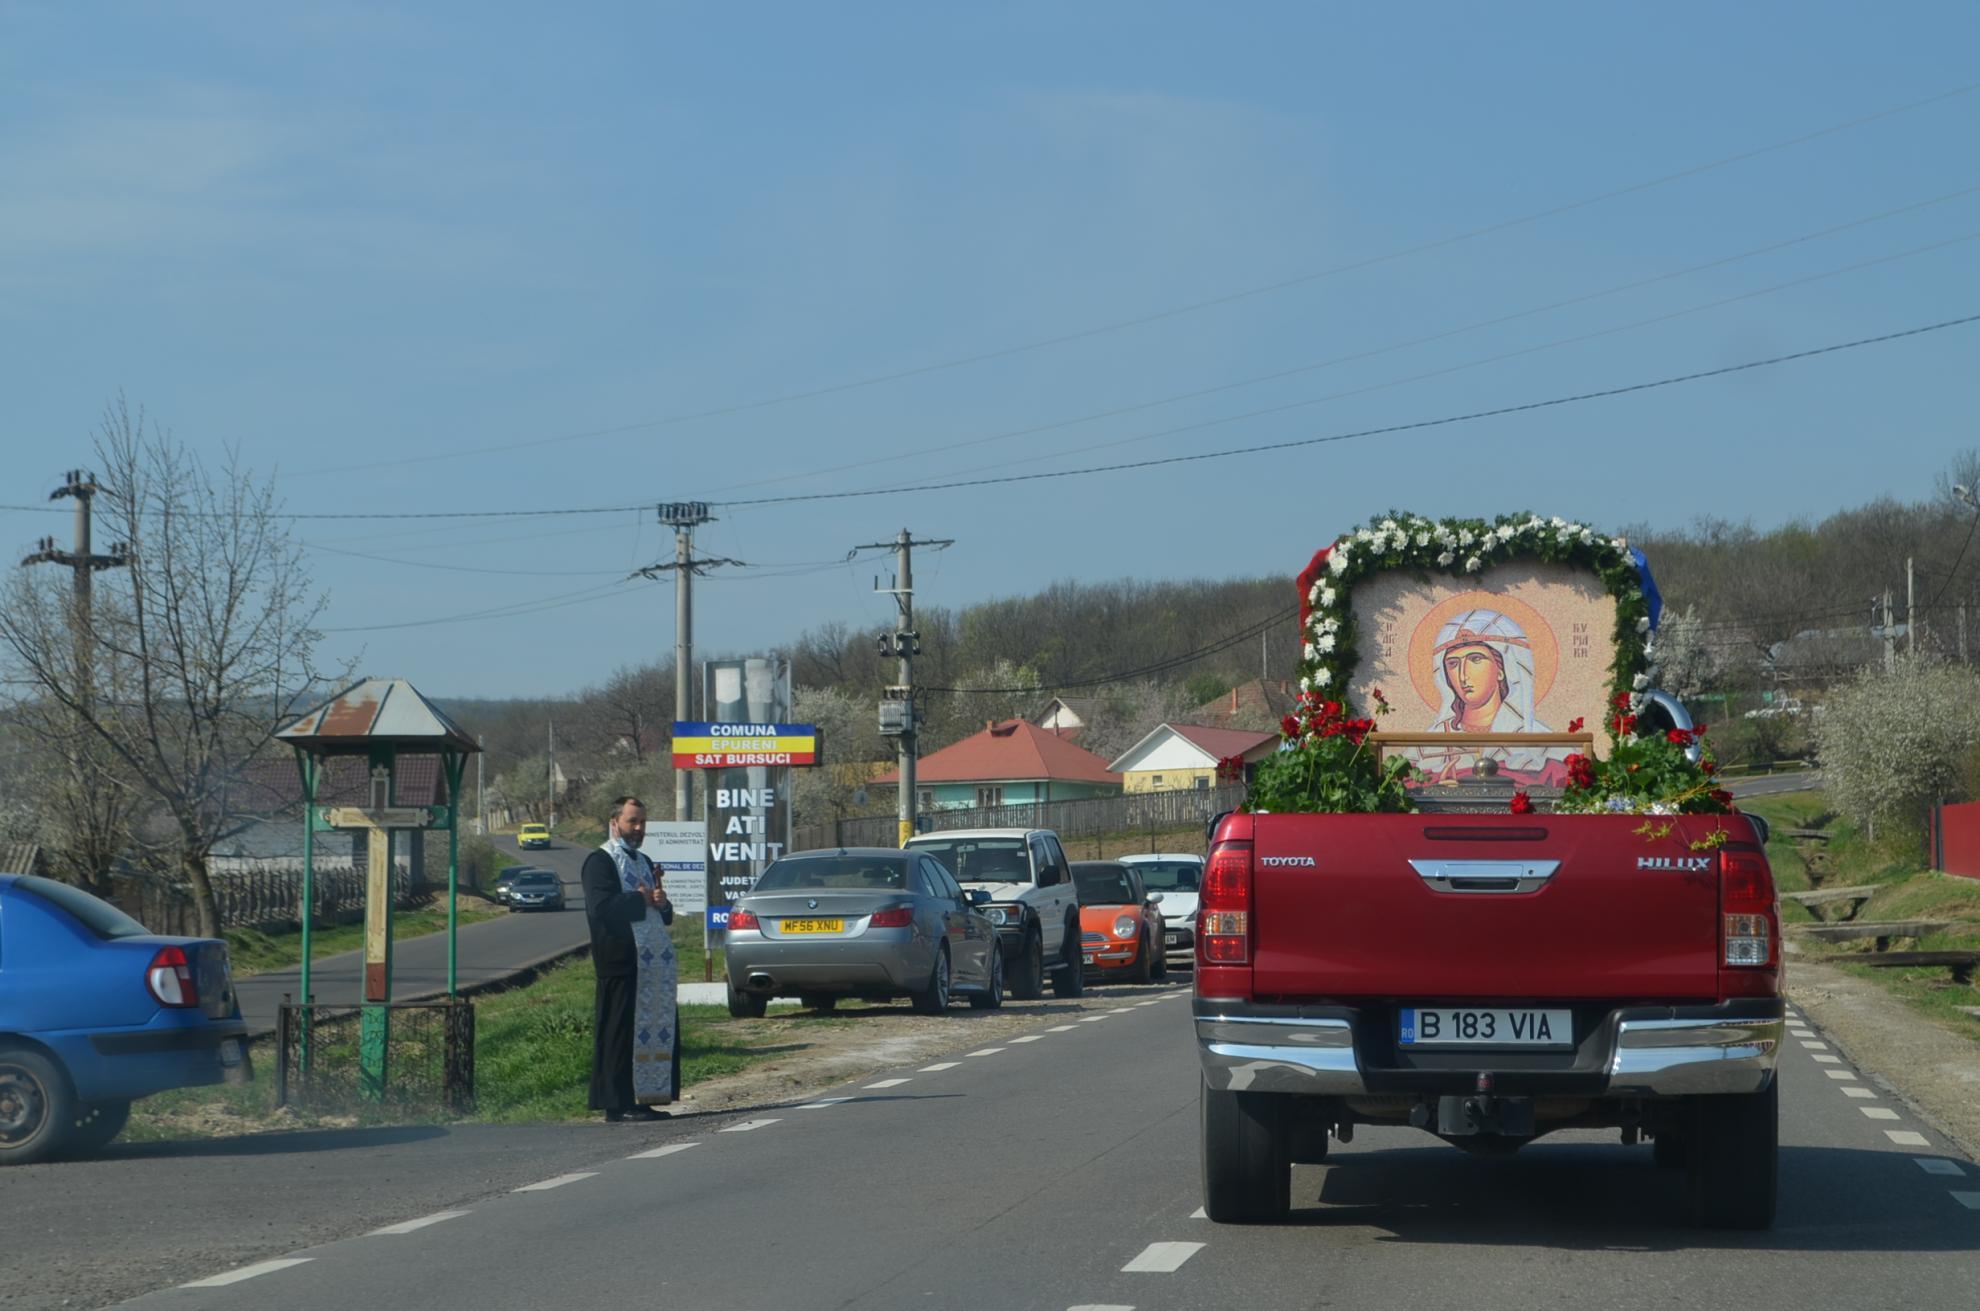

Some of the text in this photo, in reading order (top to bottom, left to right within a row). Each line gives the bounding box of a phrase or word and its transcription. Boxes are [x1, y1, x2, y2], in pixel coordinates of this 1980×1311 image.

[710, 725, 777, 736] COMUNA
[711, 739, 777, 750] EPURENI
[695, 753, 791, 764] SAT BURSUCI
[716, 788, 774, 808] BINE
[725, 816, 765, 834] ATI
[710, 842, 783, 861] VENIT
[1261, 857, 1315, 866] TOYOTA
[1637, 857, 1711, 868] HILUX
[719, 876, 758, 885] JUDET
[725, 891, 747, 900] VAS
[712, 913, 729, 923] RO
[816, 920, 838, 931] XNU
[1420, 1012, 1552, 1040] B 183 VIA
[1401, 1028, 1414, 1039] RO
